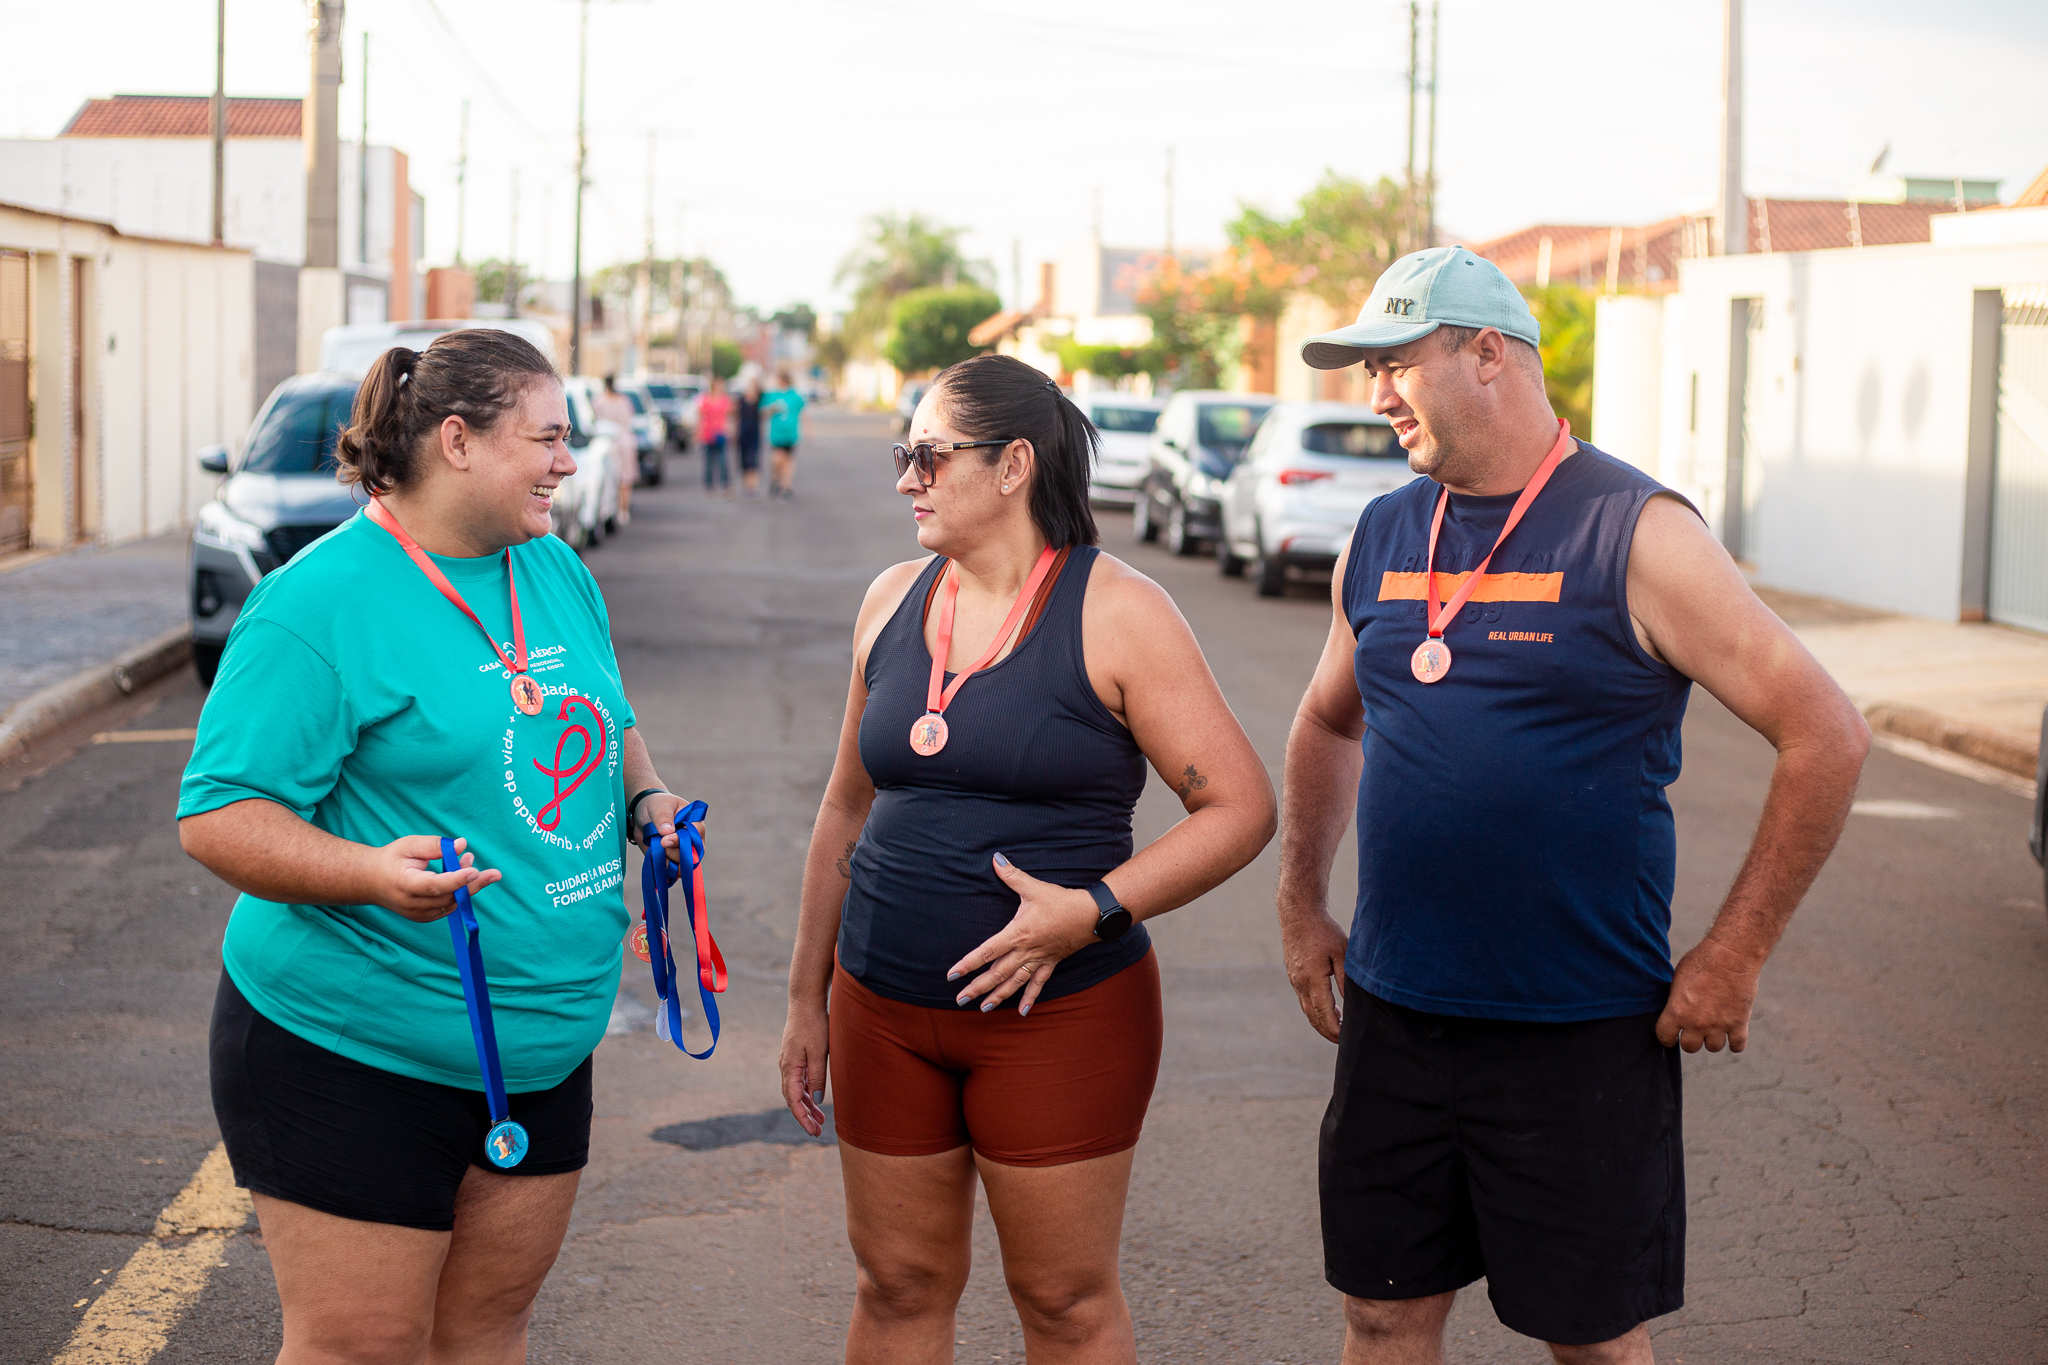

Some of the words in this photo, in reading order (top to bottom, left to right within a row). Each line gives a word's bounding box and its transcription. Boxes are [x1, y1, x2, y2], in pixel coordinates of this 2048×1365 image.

[1384, 297, 1415, 315] NY
[1488, 631, 1507, 640] REAL
[1508, 631, 1536, 641] URBAN
[1536, 632, 1554, 643] LIFE
[478, 661, 502, 672] CASA
[502, 729, 514, 765] vida
[504, 769, 517, 793] de
[513, 796, 572, 850] qualidade
[545, 873, 589, 895] CUIDAR
[553, 886, 594, 908] FORMA
